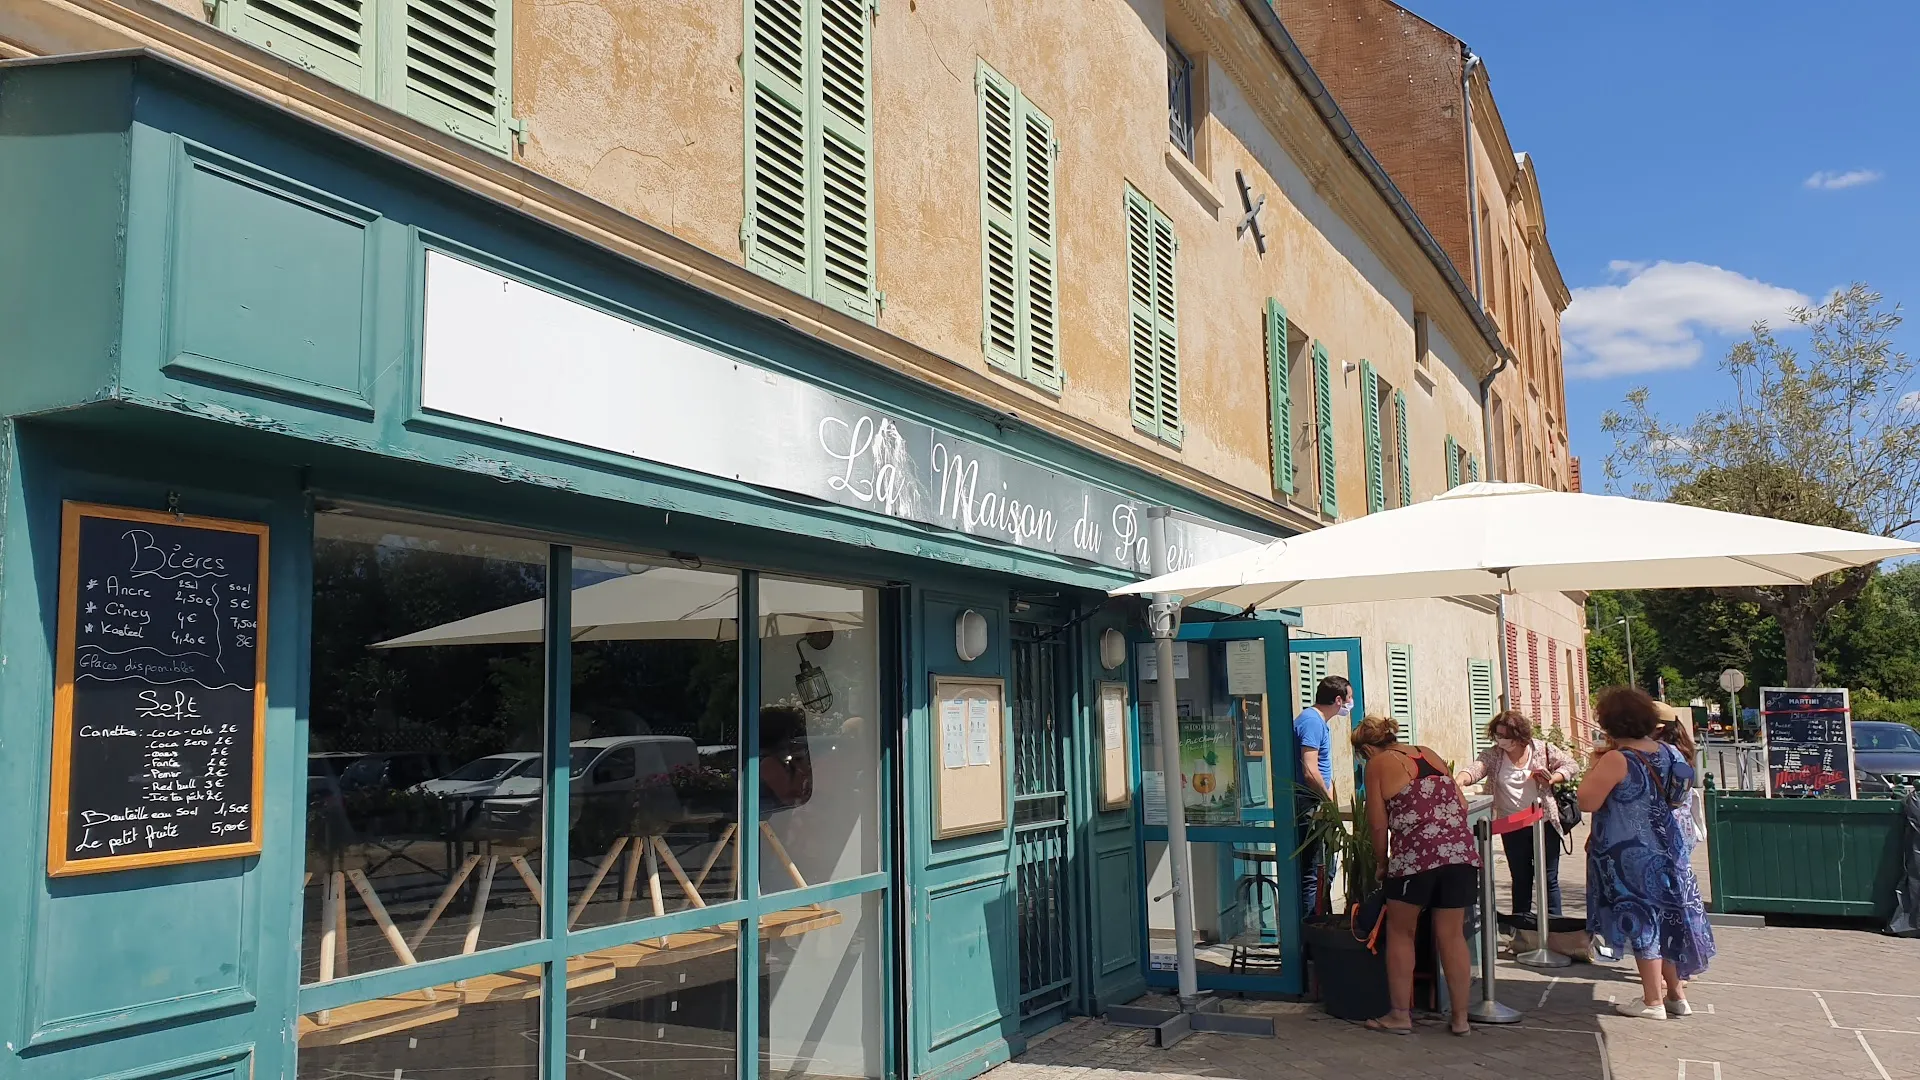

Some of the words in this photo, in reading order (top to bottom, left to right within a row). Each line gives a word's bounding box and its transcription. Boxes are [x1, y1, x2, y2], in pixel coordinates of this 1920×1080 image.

[818, 414, 903, 503] La
[931, 441, 1058, 543] Maison
[1074, 494, 1103, 553] du
[121, 529, 225, 573] Bières
[107, 575, 152, 598] Ancre
[105, 602, 151, 625] Ciney
[124, 658, 195, 676] disponibles
[136, 690, 198, 720] Soft
[81, 806, 149, 827] Bouteille
[150, 811, 172, 819] eau
[75, 828, 102, 852] Le
[108, 827, 139, 854] petit
[144, 822, 179, 849] fruité
